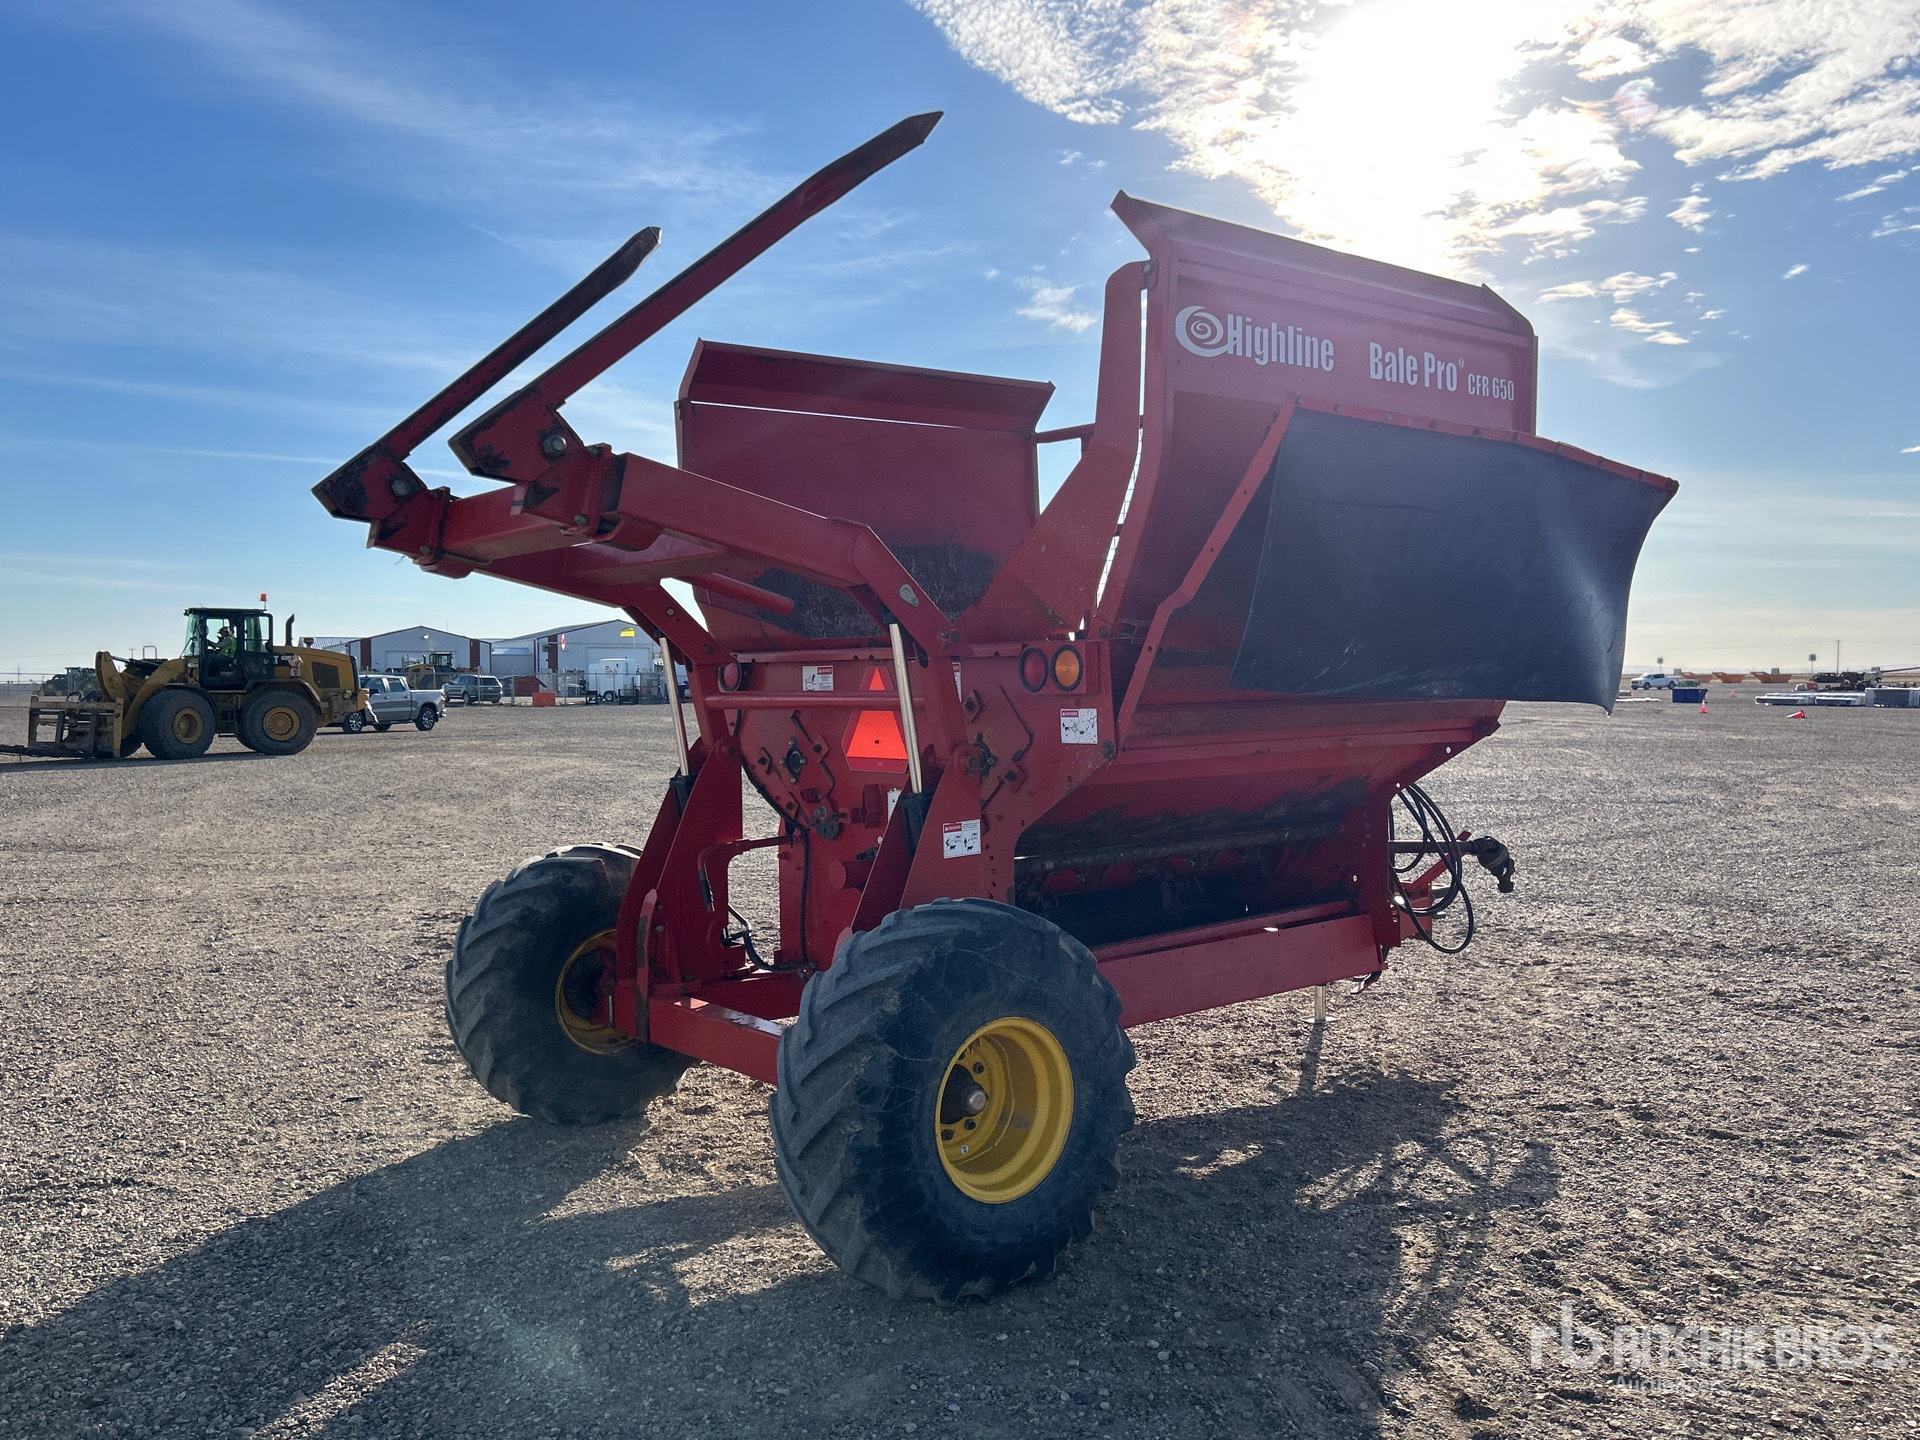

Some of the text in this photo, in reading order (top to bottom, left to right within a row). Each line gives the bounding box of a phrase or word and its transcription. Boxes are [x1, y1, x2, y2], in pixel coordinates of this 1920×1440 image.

[1227, 313, 1335, 372] Highline
[1369, 341, 1419, 386] Bale
[1468, 373, 1490, 397] CFR
[1492, 377, 1515, 401] 650
